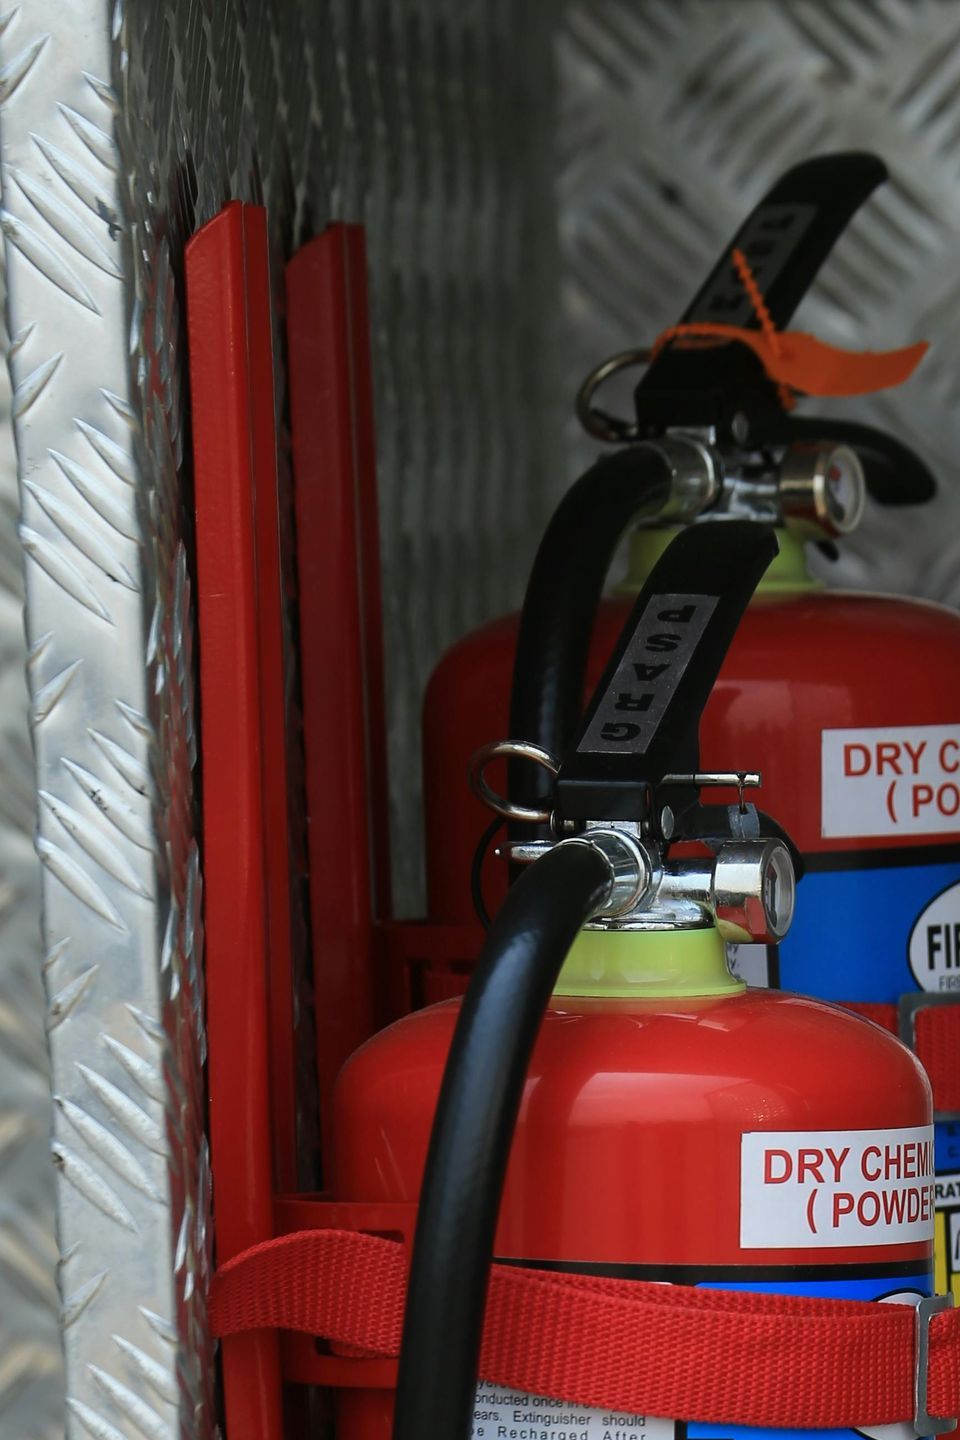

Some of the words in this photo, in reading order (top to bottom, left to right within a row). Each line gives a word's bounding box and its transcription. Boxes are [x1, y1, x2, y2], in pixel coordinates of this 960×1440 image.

[599, 605, 697, 742] GRASP
[843, 740, 928, 777] DRY
[763, 1146, 851, 1184] DRY
[473, 1410, 503, 1421] ears.
[512, 1410, 592, 1427] Extinguisher
[601, 1414, 647, 1428] should
[474, 1393, 529, 1408] onducted
